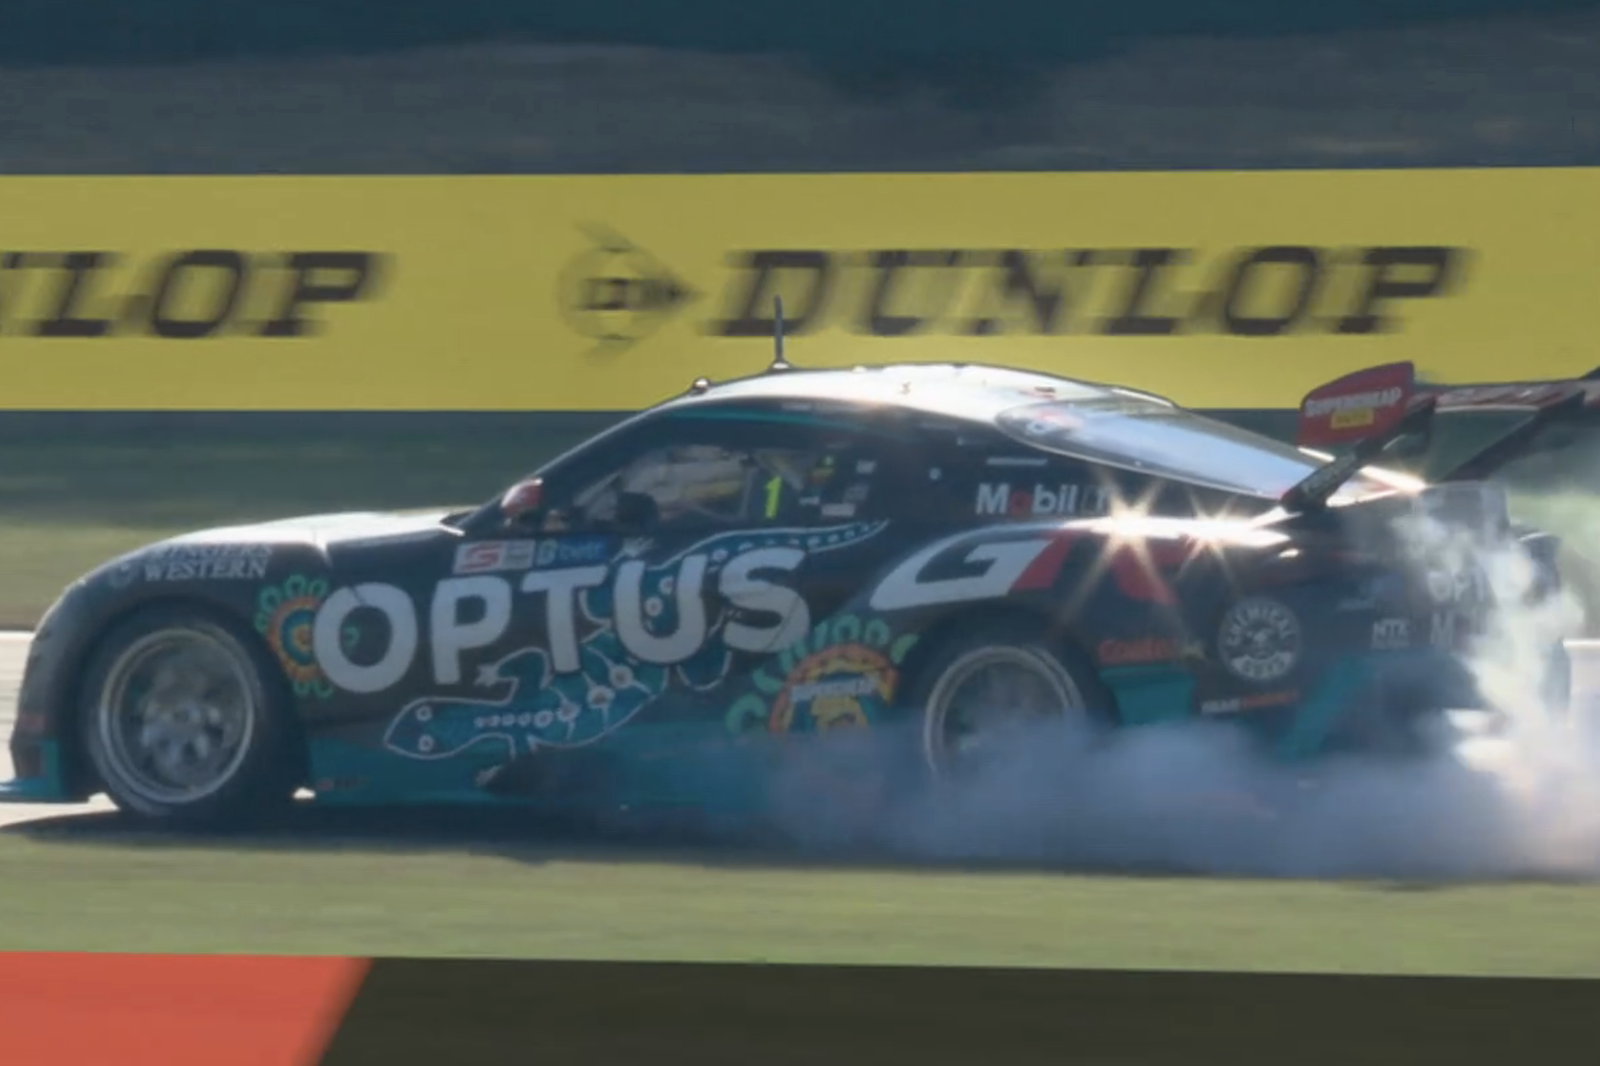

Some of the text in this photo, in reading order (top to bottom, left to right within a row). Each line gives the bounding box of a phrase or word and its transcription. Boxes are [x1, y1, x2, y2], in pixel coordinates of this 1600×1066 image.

[0, 248, 388, 338] LOP
[705, 246, 1472, 337] DUNLOP
[764, 476, 781, 519] 1
[975, 482, 1078, 515] Mobil
[144, 558, 269, 582] WESTERN
[312, 547, 810, 693] OPTUS
